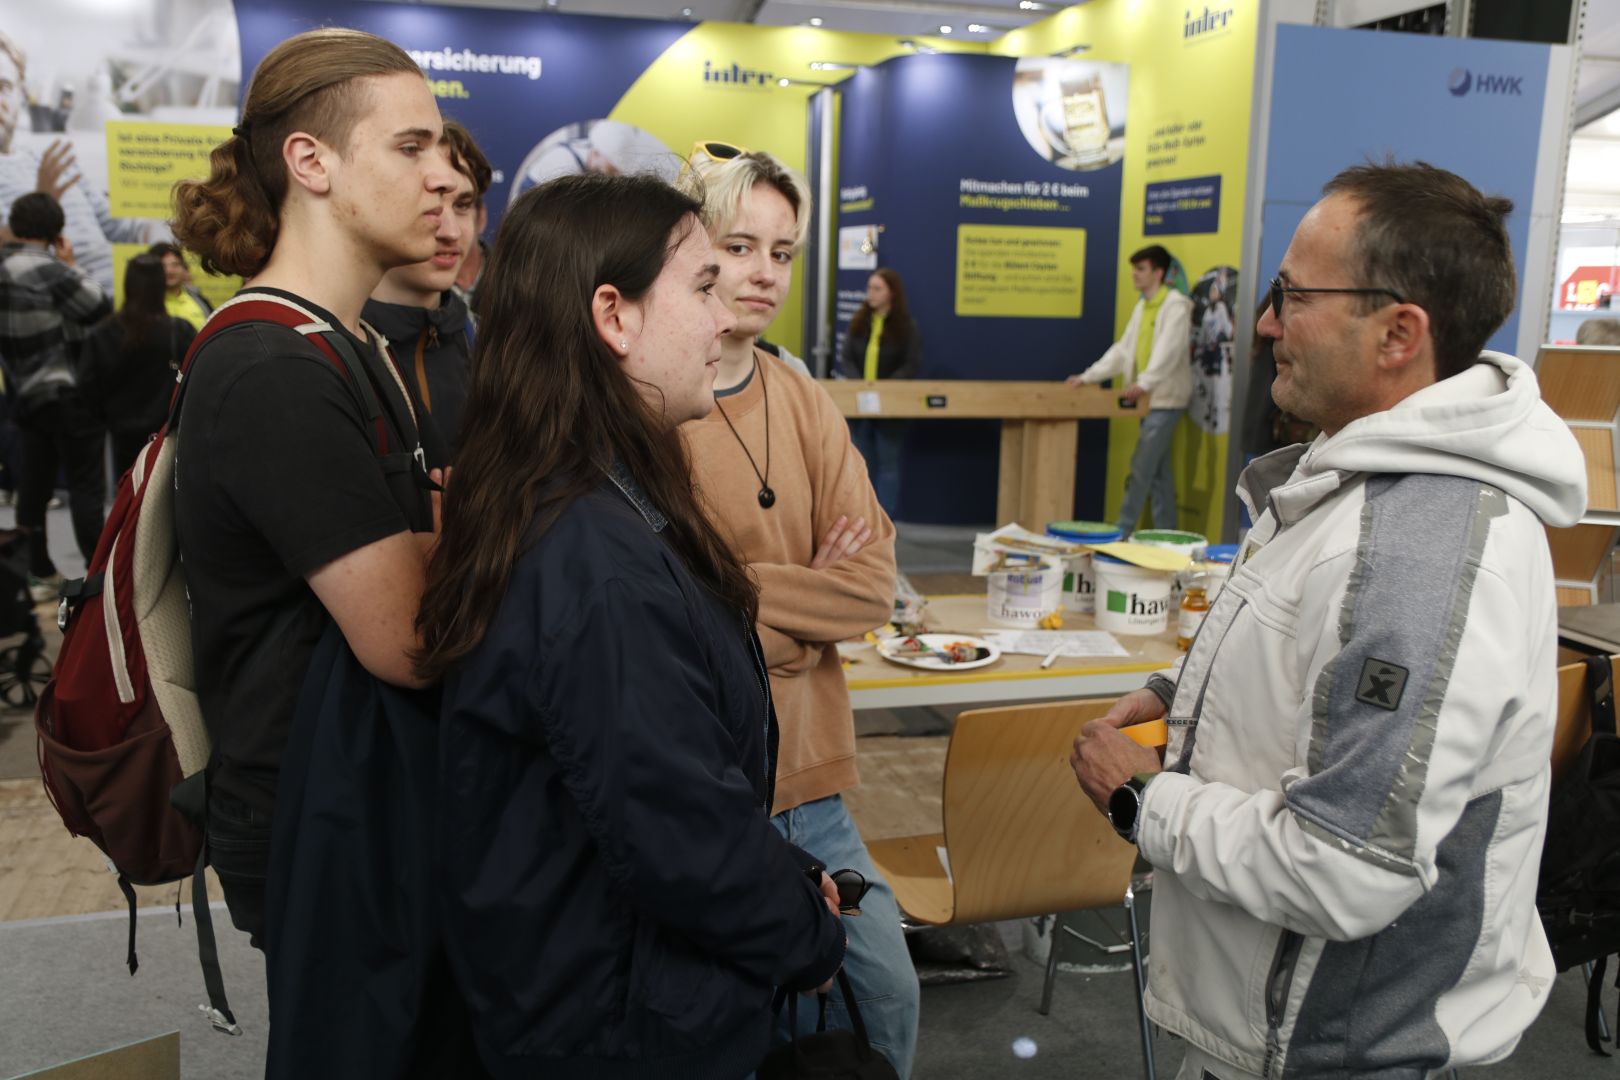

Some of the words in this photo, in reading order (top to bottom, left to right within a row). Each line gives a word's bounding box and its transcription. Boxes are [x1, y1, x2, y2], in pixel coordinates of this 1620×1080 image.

[406, 47, 541, 79] ersicherung
[704, 60, 773, 84] inter
[1477, 74, 1523, 96] HWK
[960, 179, 1022, 194] Mitmachen
[1024, 181, 1041, 195] für
[1042, 182, 1051, 196] 2
[1052, 183, 1060, 197] €
[1061, 183, 1089, 198] beim
